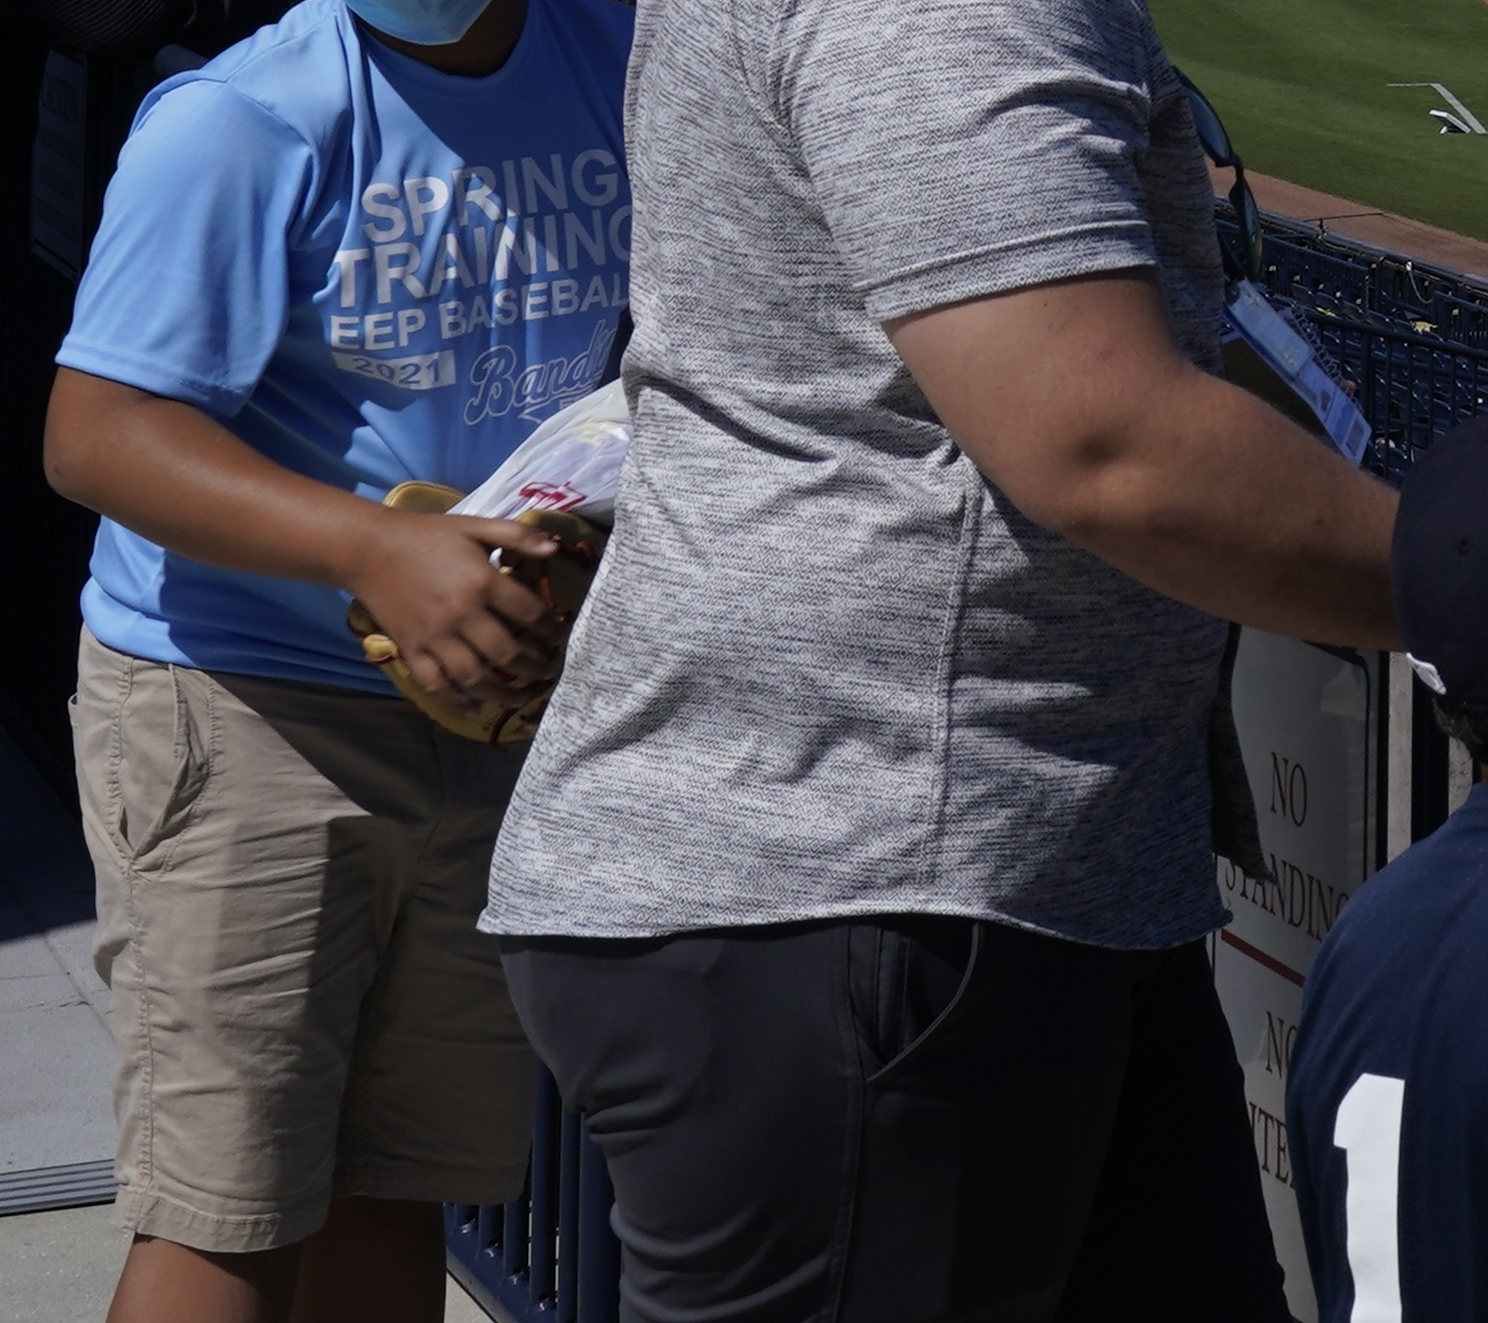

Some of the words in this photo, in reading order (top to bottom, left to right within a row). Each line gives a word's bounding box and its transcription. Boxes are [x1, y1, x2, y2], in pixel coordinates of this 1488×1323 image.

[361, 149, 619, 244] SPRING
[330, 309, 426, 350] EEP
[439, 273, 630, 340] BASEBAL
[352, 357, 441, 386] 2021
[1269, 750, 1308, 828] NO
